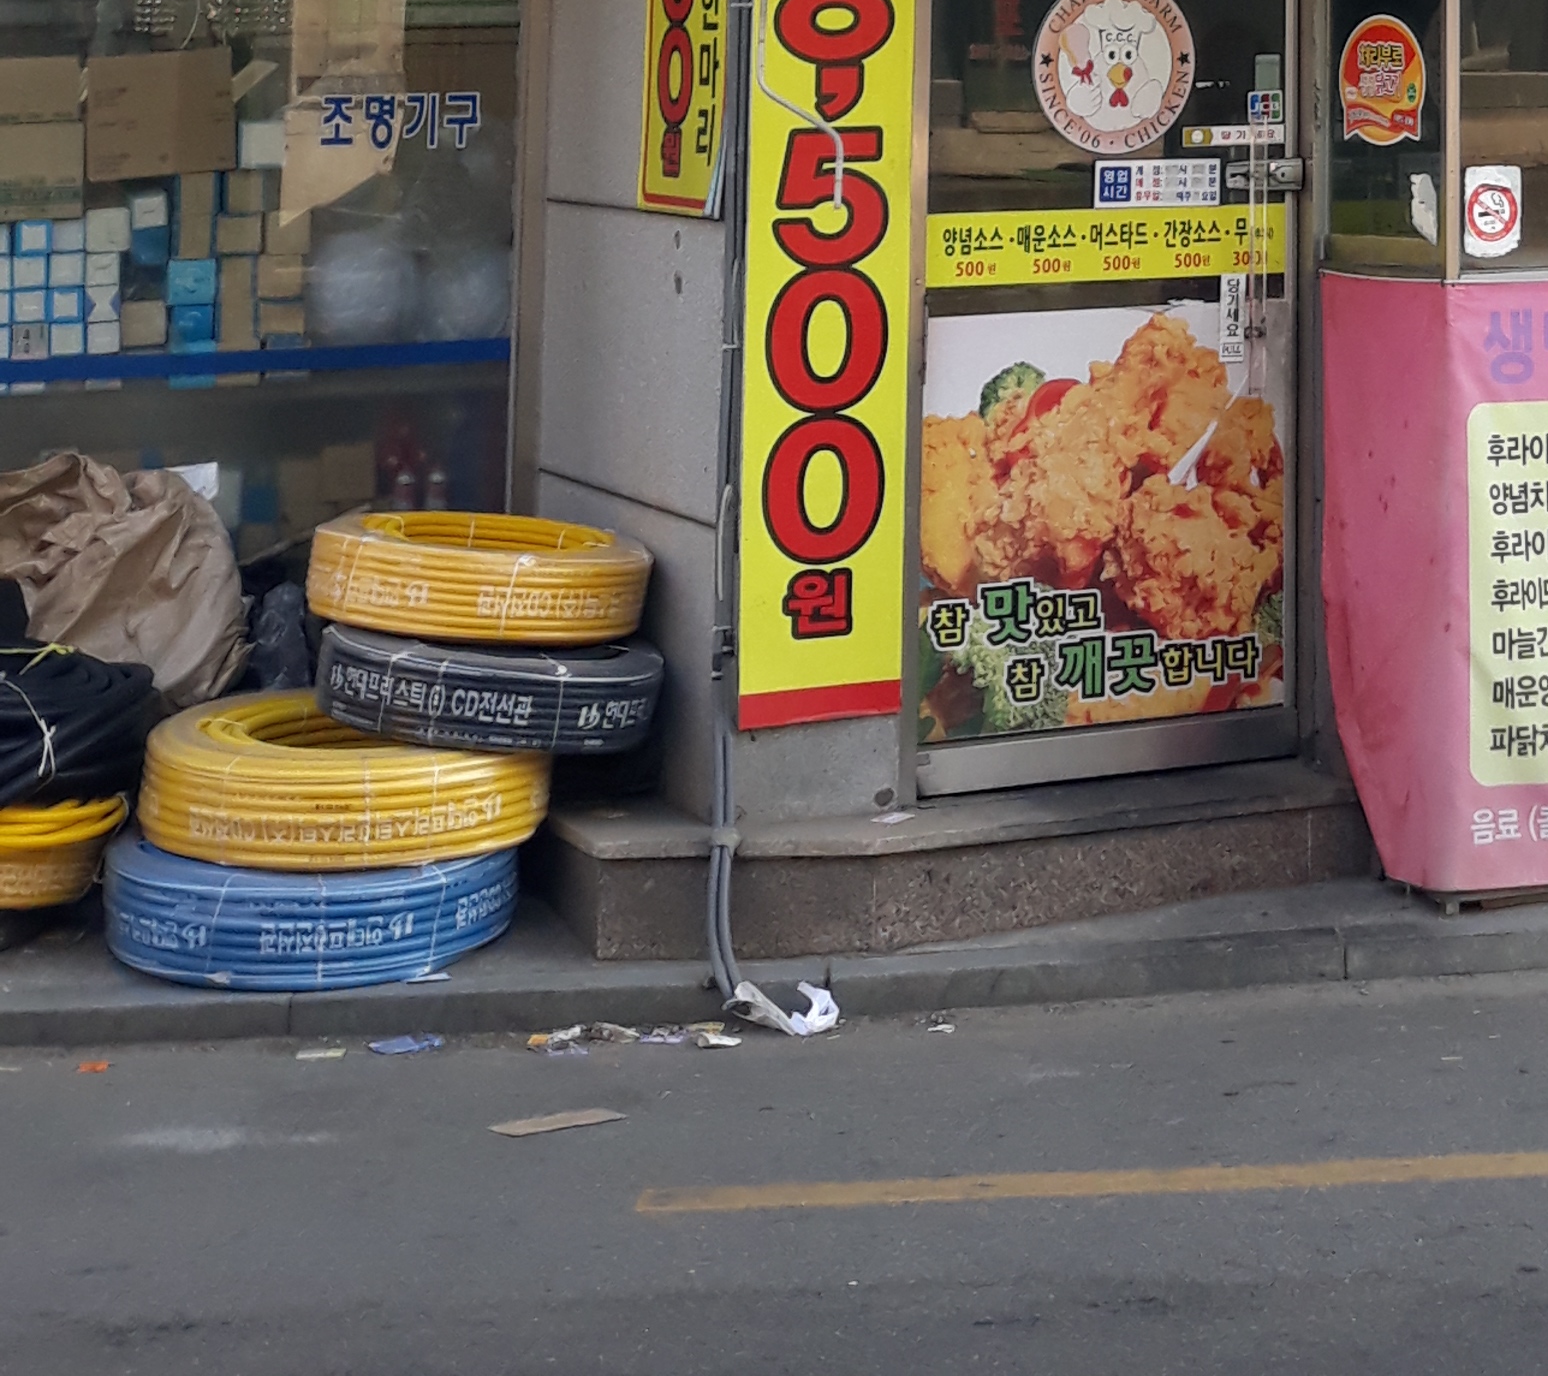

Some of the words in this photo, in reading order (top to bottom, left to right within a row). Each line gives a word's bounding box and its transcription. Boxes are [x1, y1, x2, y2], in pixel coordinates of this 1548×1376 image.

[320, 92, 481, 150] 조명기구
[1123, 69, 1191, 150] CHICKEN
[1103, 186, 1128, 200] 시간
[942, 224, 1005, 257] 양념소스
[1016, 222, 1078, 254] 매운소스
[1089, 221, 1150, 252] 머스타드
[1163, 218, 1222, 249] 간장소스
[1226, 278, 1240, 337] 당기세요
[931, 602, 967, 645] 참
[982, 582, 1100, 645] 맛있고
[1008, 659, 1042, 702] 참
[1057, 635, 1260, 698] 깨끗합니다
[1470, 808, 1522, 846] 음료
